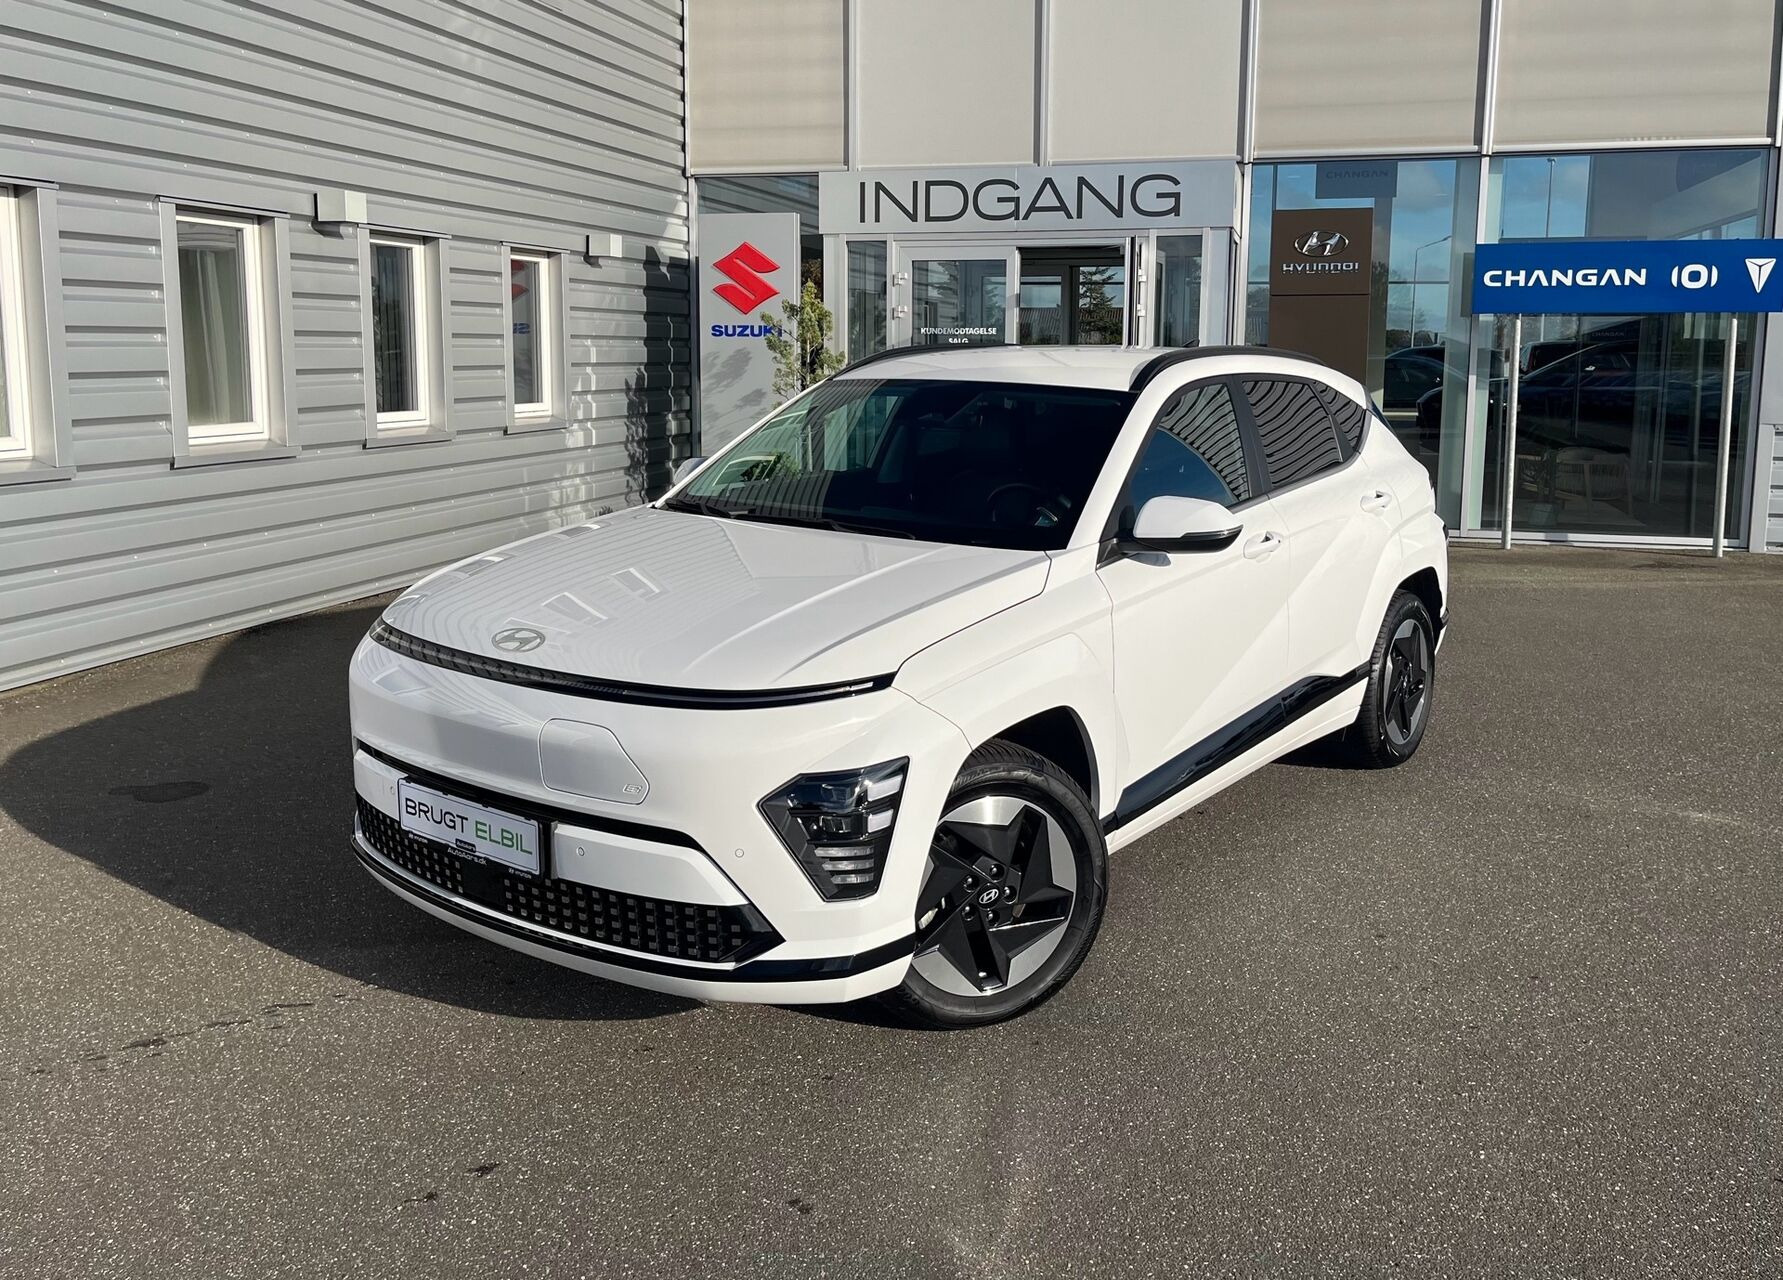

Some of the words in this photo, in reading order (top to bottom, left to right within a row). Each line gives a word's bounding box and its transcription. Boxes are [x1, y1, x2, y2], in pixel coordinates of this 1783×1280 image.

[859, 174, 1182, 223] INDGANG
[1282, 262, 1360, 274] HYUNDAI
[1482, 268, 1647, 287] CHANGAN
[711, 324, 783, 338] SUZUKI
[920, 327, 997, 335] KUNDEMODTAGELSE
[405, 797, 469, 834] BRUGT
[475, 820, 533, 855] ELBIL
